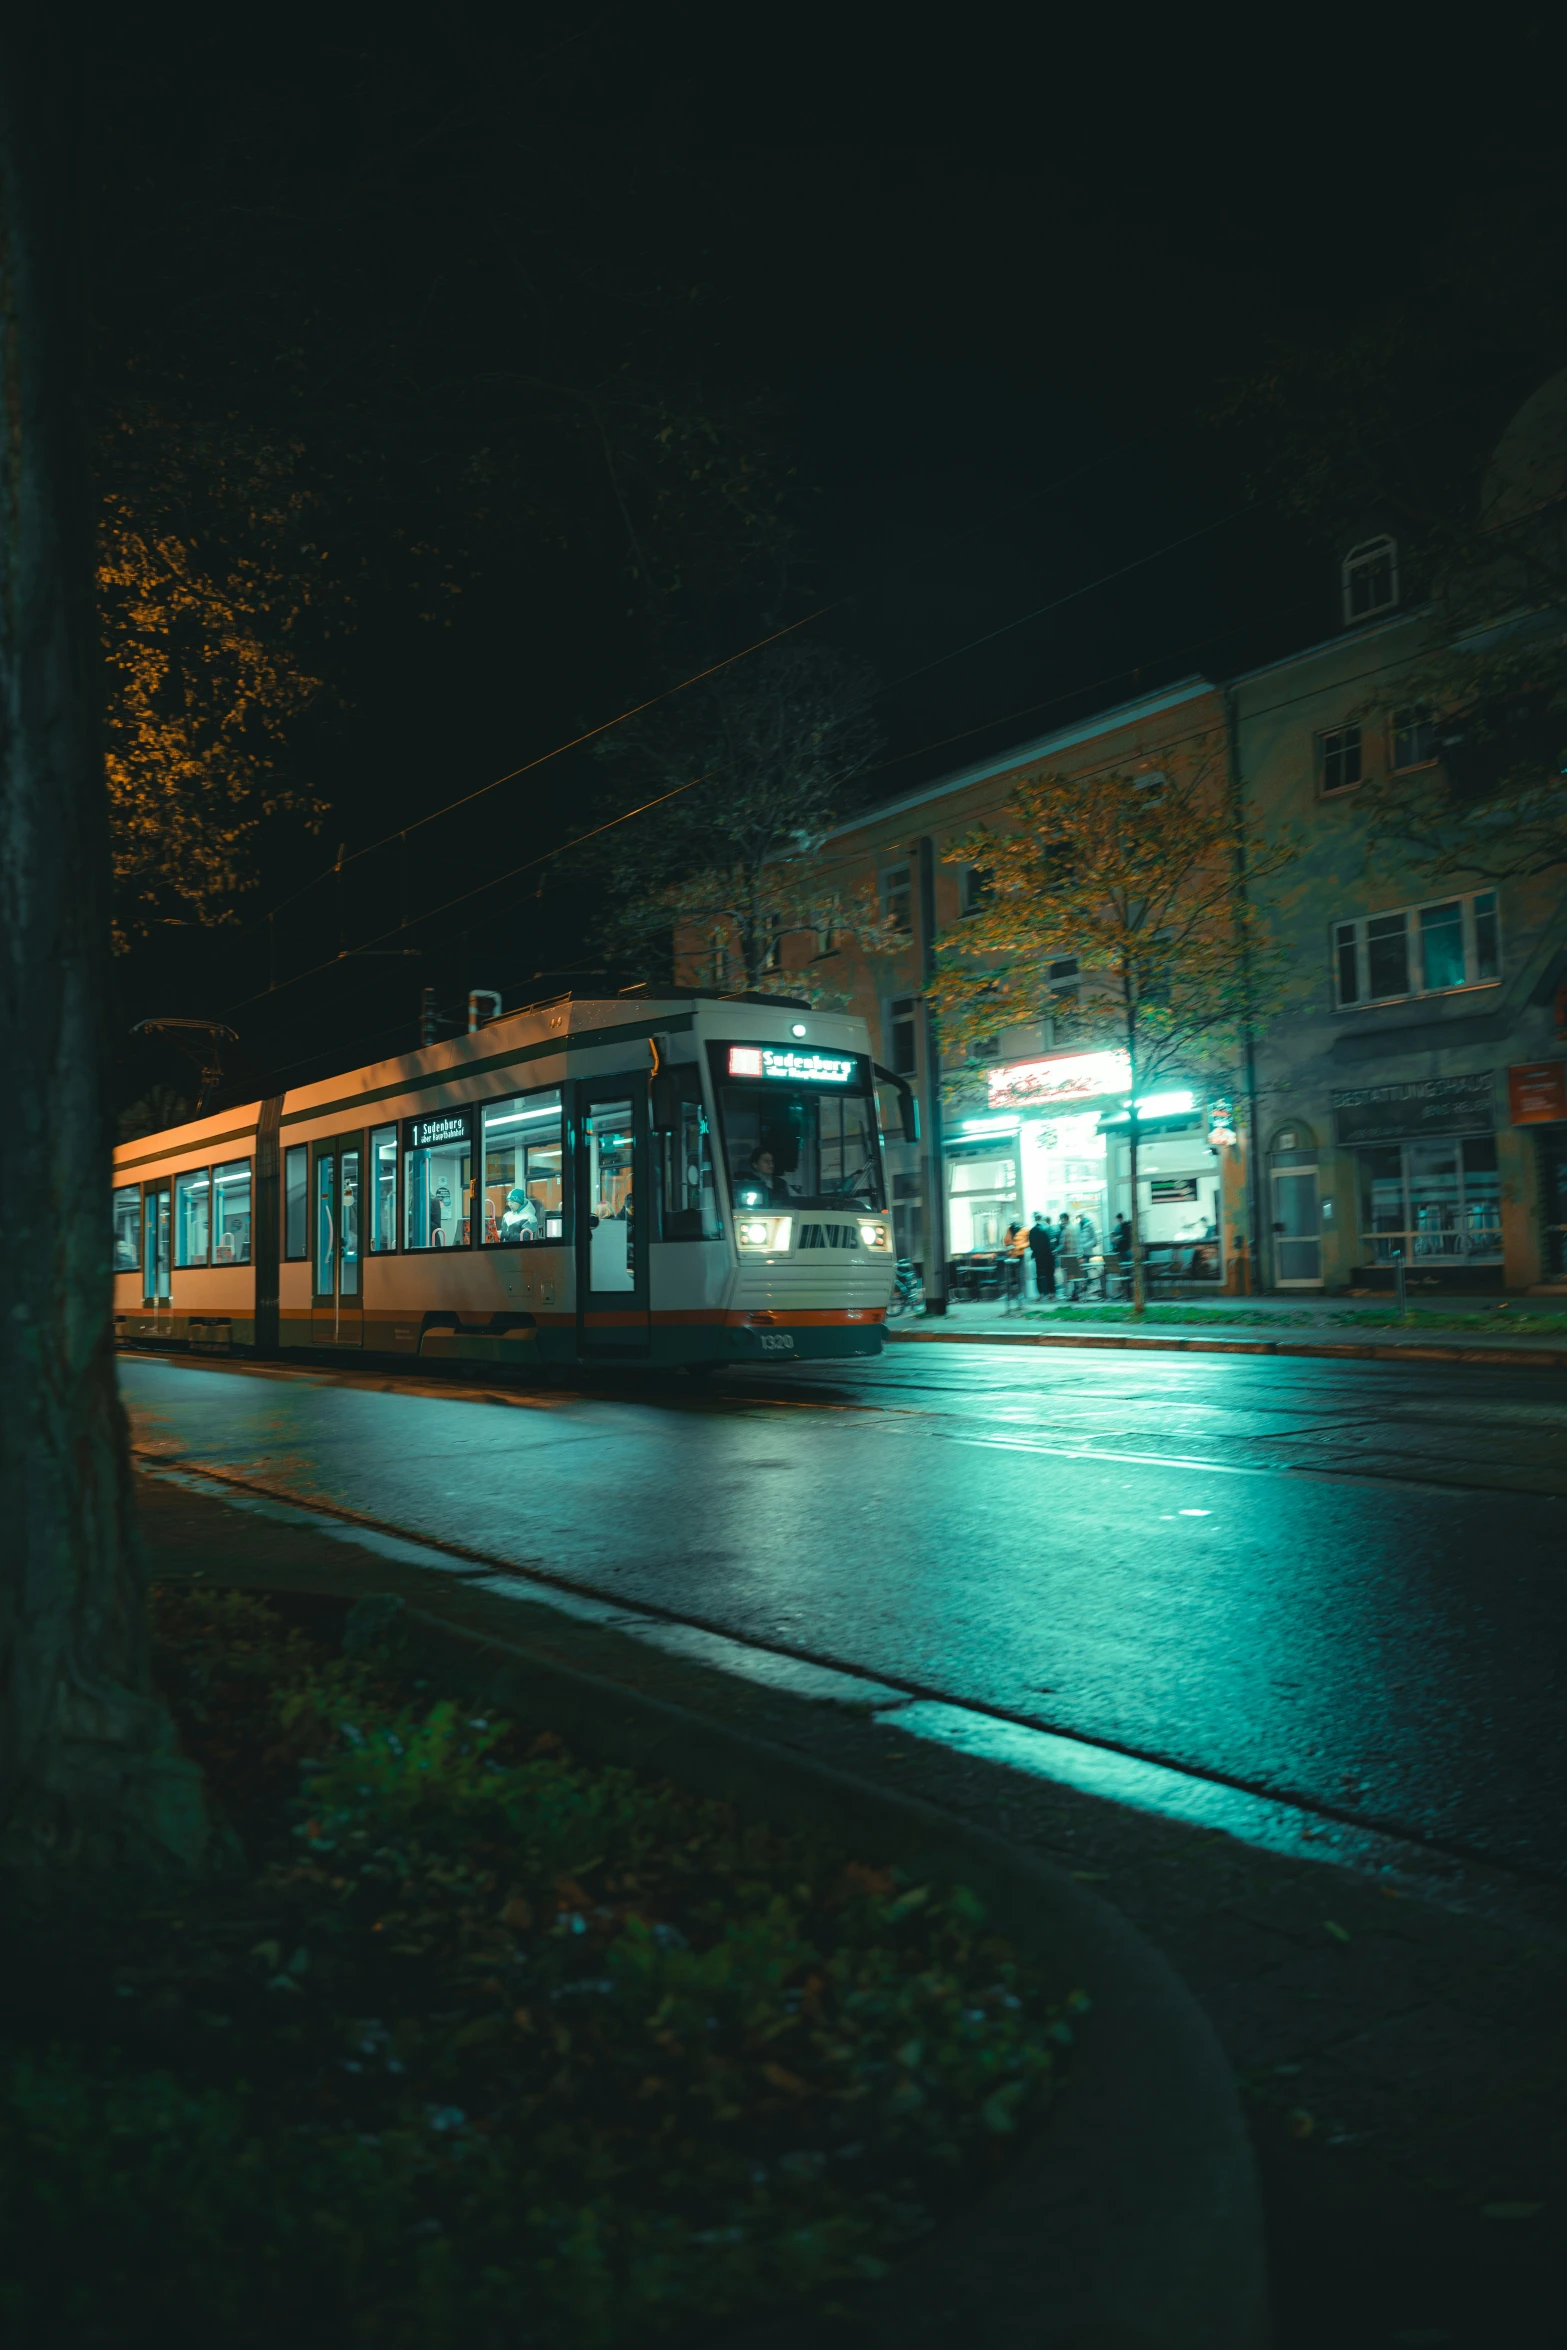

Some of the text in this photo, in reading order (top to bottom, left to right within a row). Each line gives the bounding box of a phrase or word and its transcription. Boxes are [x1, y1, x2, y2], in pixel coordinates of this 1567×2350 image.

[762, 1051, 851, 1073] Sudenburg
[413, 1119, 462, 1146] 1 Sudenburg
[433, 1127, 464, 1141] Hauptbahnhof
[759, 1334, 795, 1350] 1320
